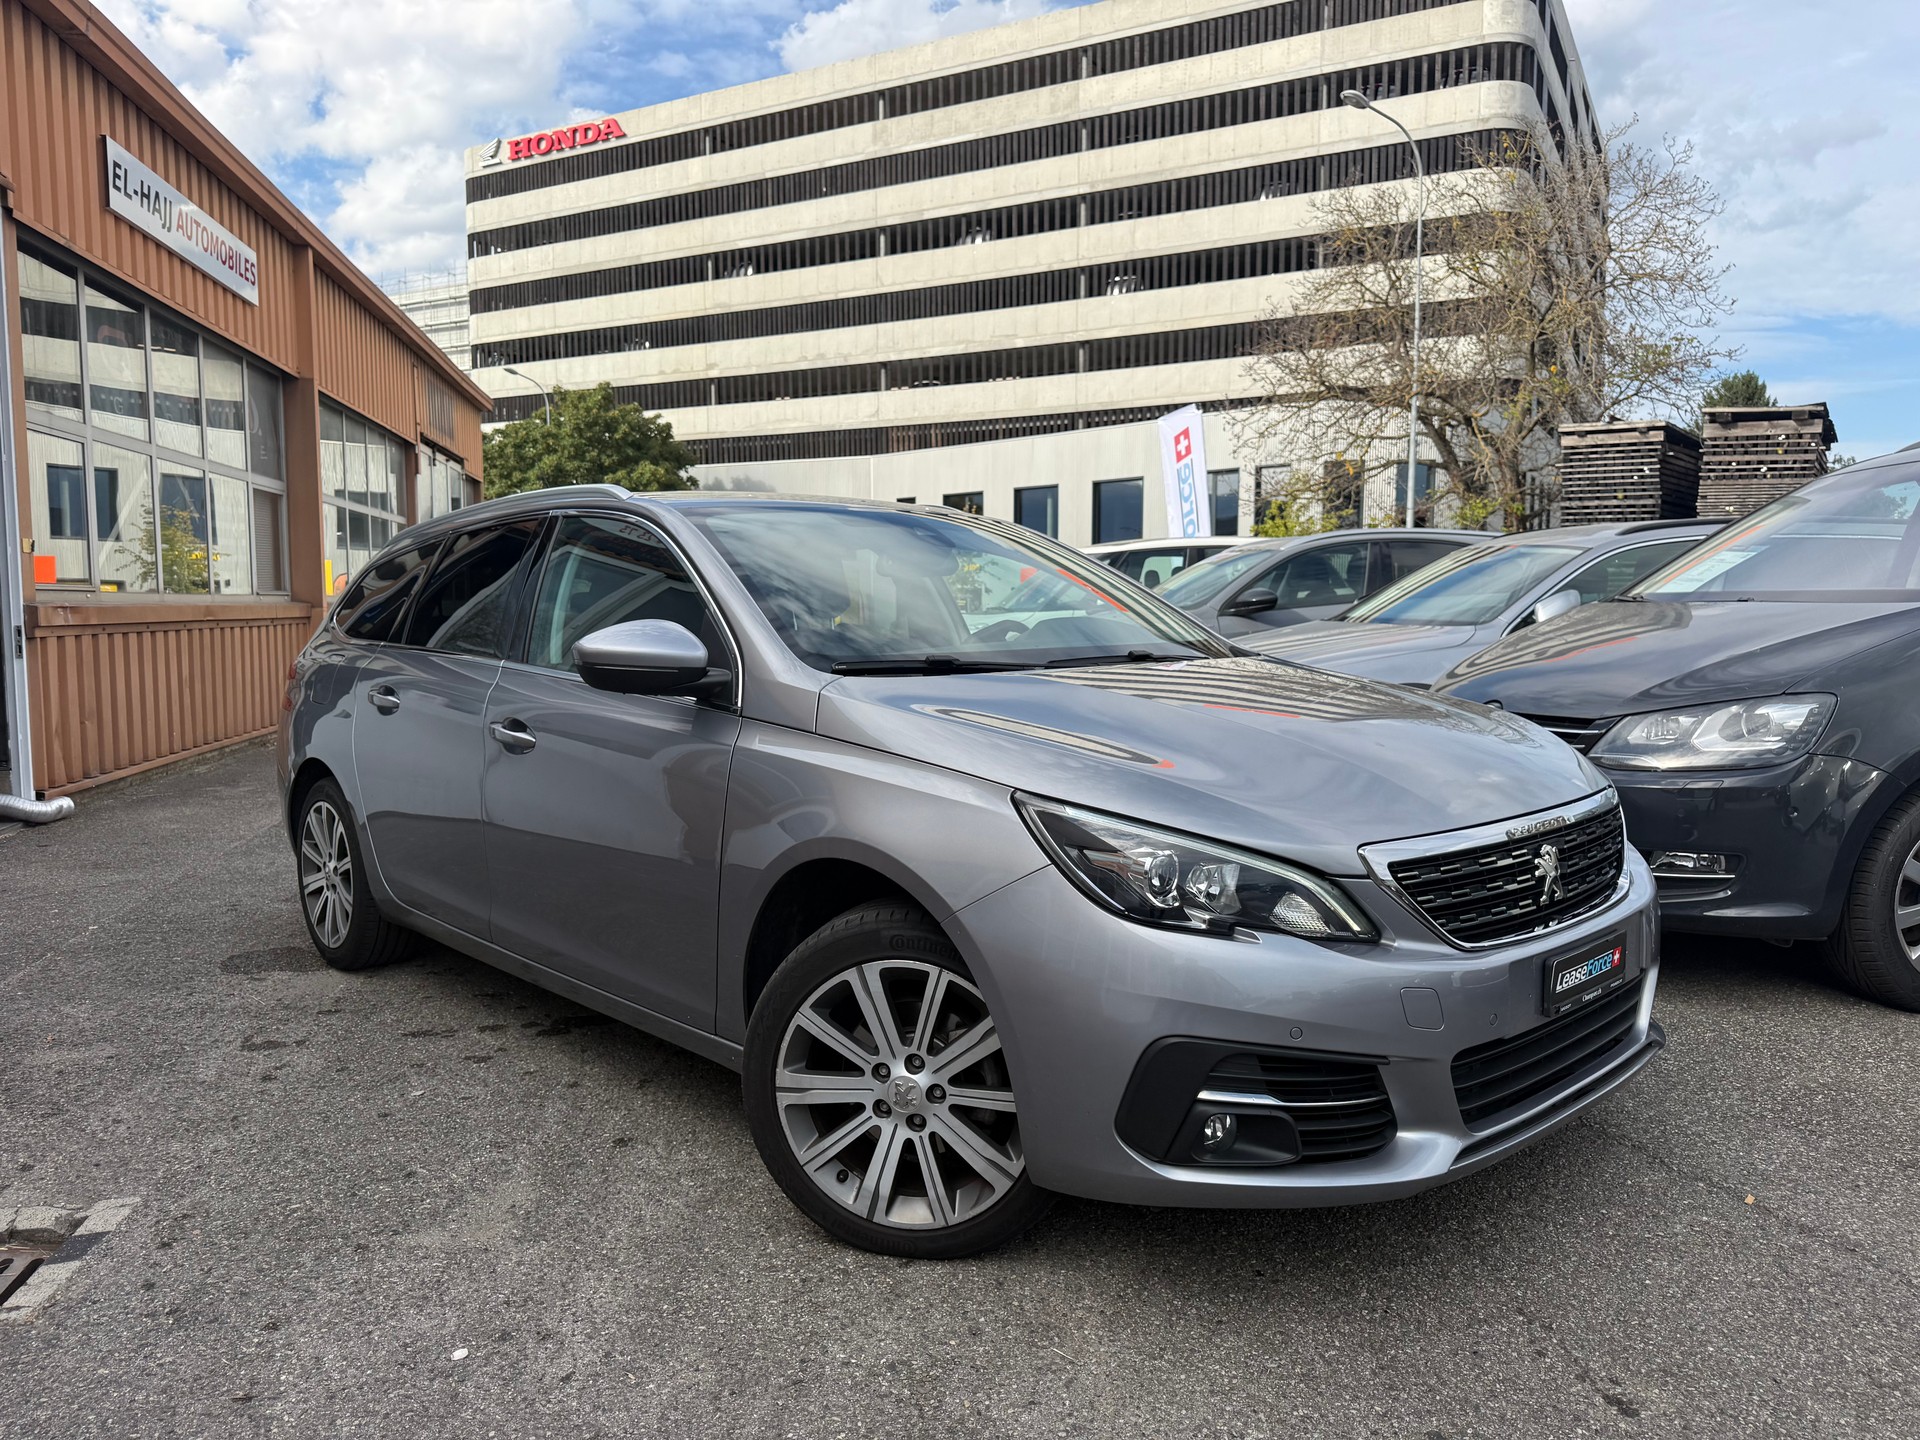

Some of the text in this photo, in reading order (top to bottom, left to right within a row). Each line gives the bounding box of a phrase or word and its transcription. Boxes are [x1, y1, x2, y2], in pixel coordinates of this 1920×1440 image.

[507, 118, 626, 160] HONDA
[112, 159, 256, 287] EL-HAJJ AUTOMOBILES
[1510, 815, 1566, 838] PEUGEOT
[1556, 952, 1614, 991] LeaseForce
